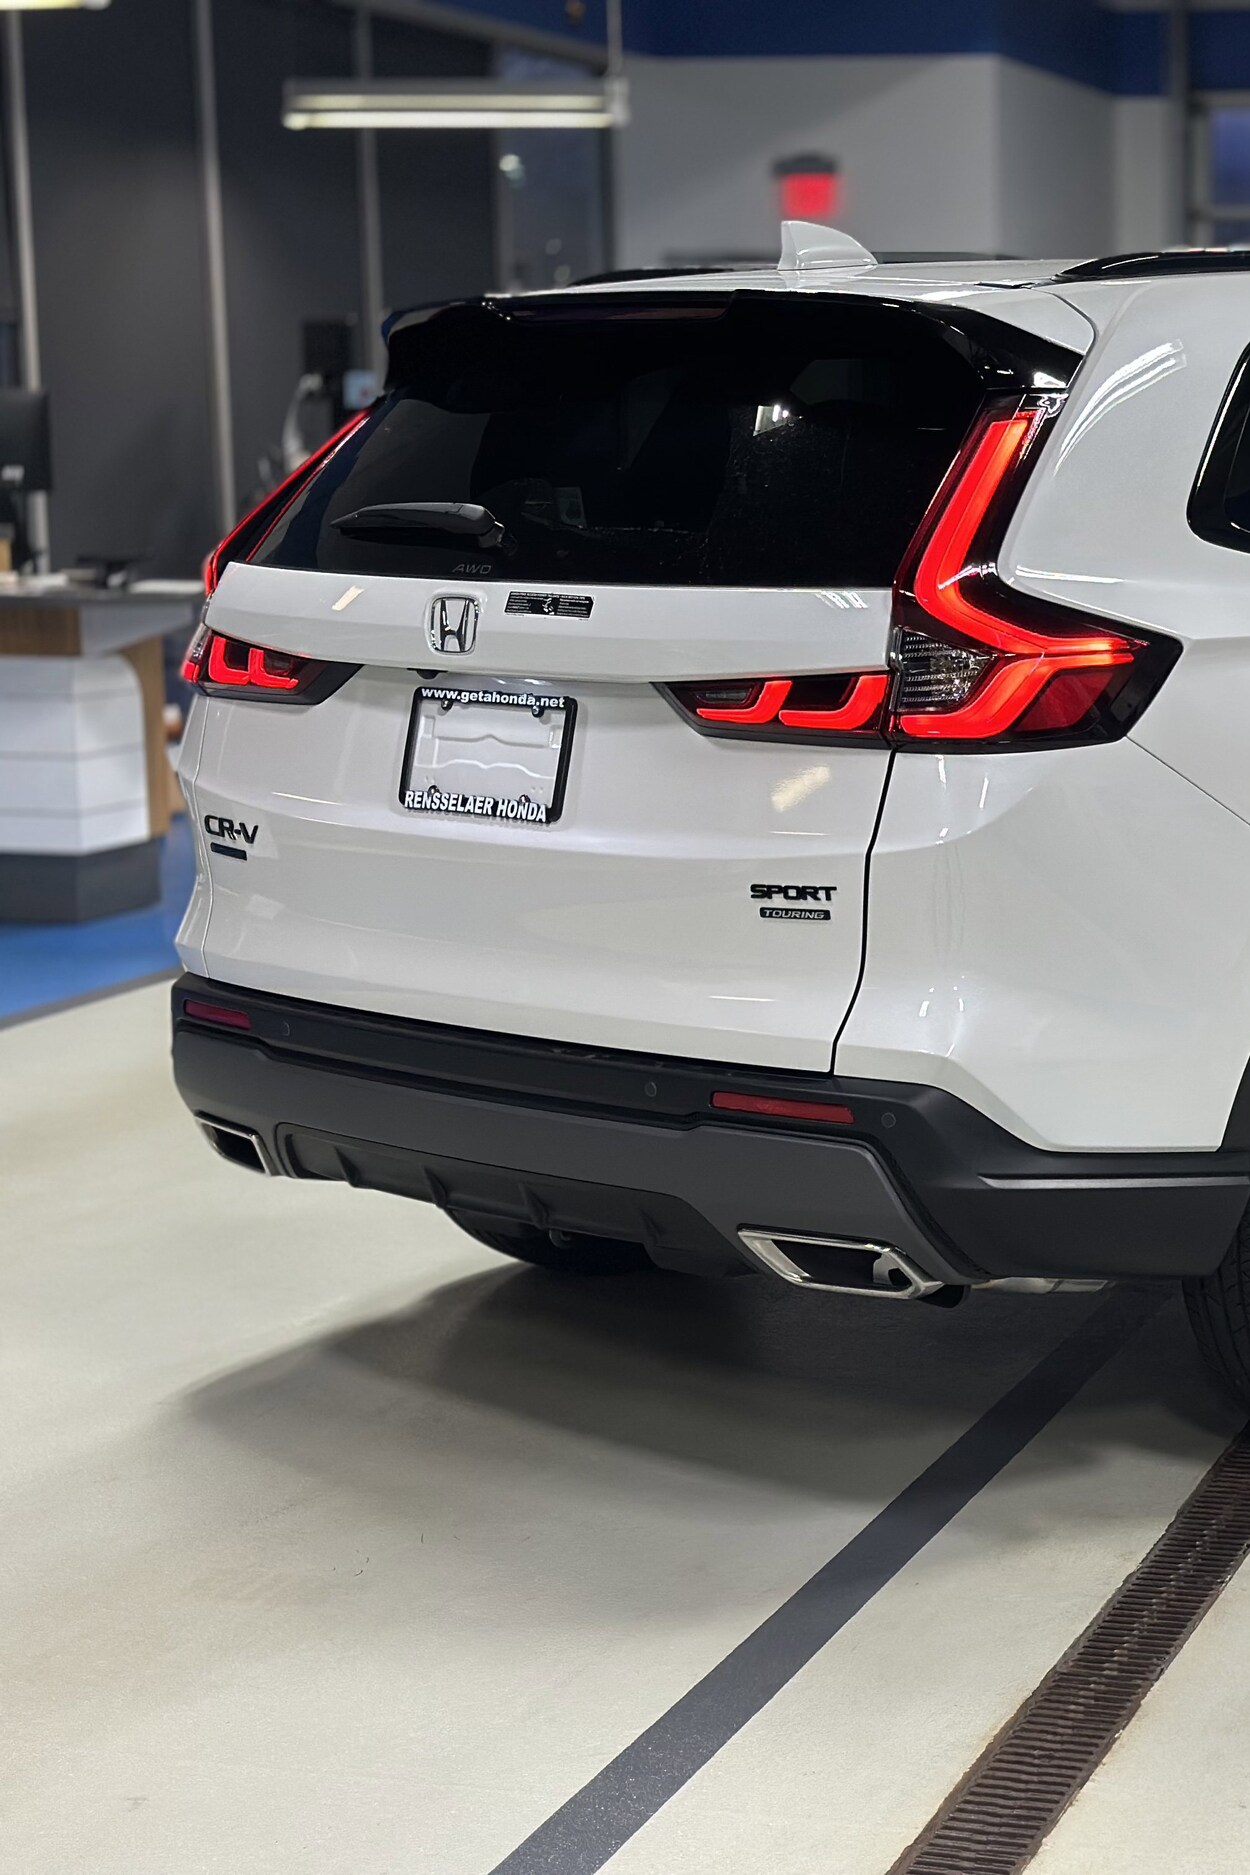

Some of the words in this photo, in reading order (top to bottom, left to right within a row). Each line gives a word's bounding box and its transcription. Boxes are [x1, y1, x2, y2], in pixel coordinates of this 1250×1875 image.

[452, 564, 492, 574] AWD
[421, 688, 565, 707] www.getahonda.net
[404, 791, 494, 815] RENSSELAER
[496, 799, 547, 822] HONDA
[204, 815, 259, 844] CR-V
[750, 884, 837, 901] SPORT
[763, 909, 825, 919] TOURING
